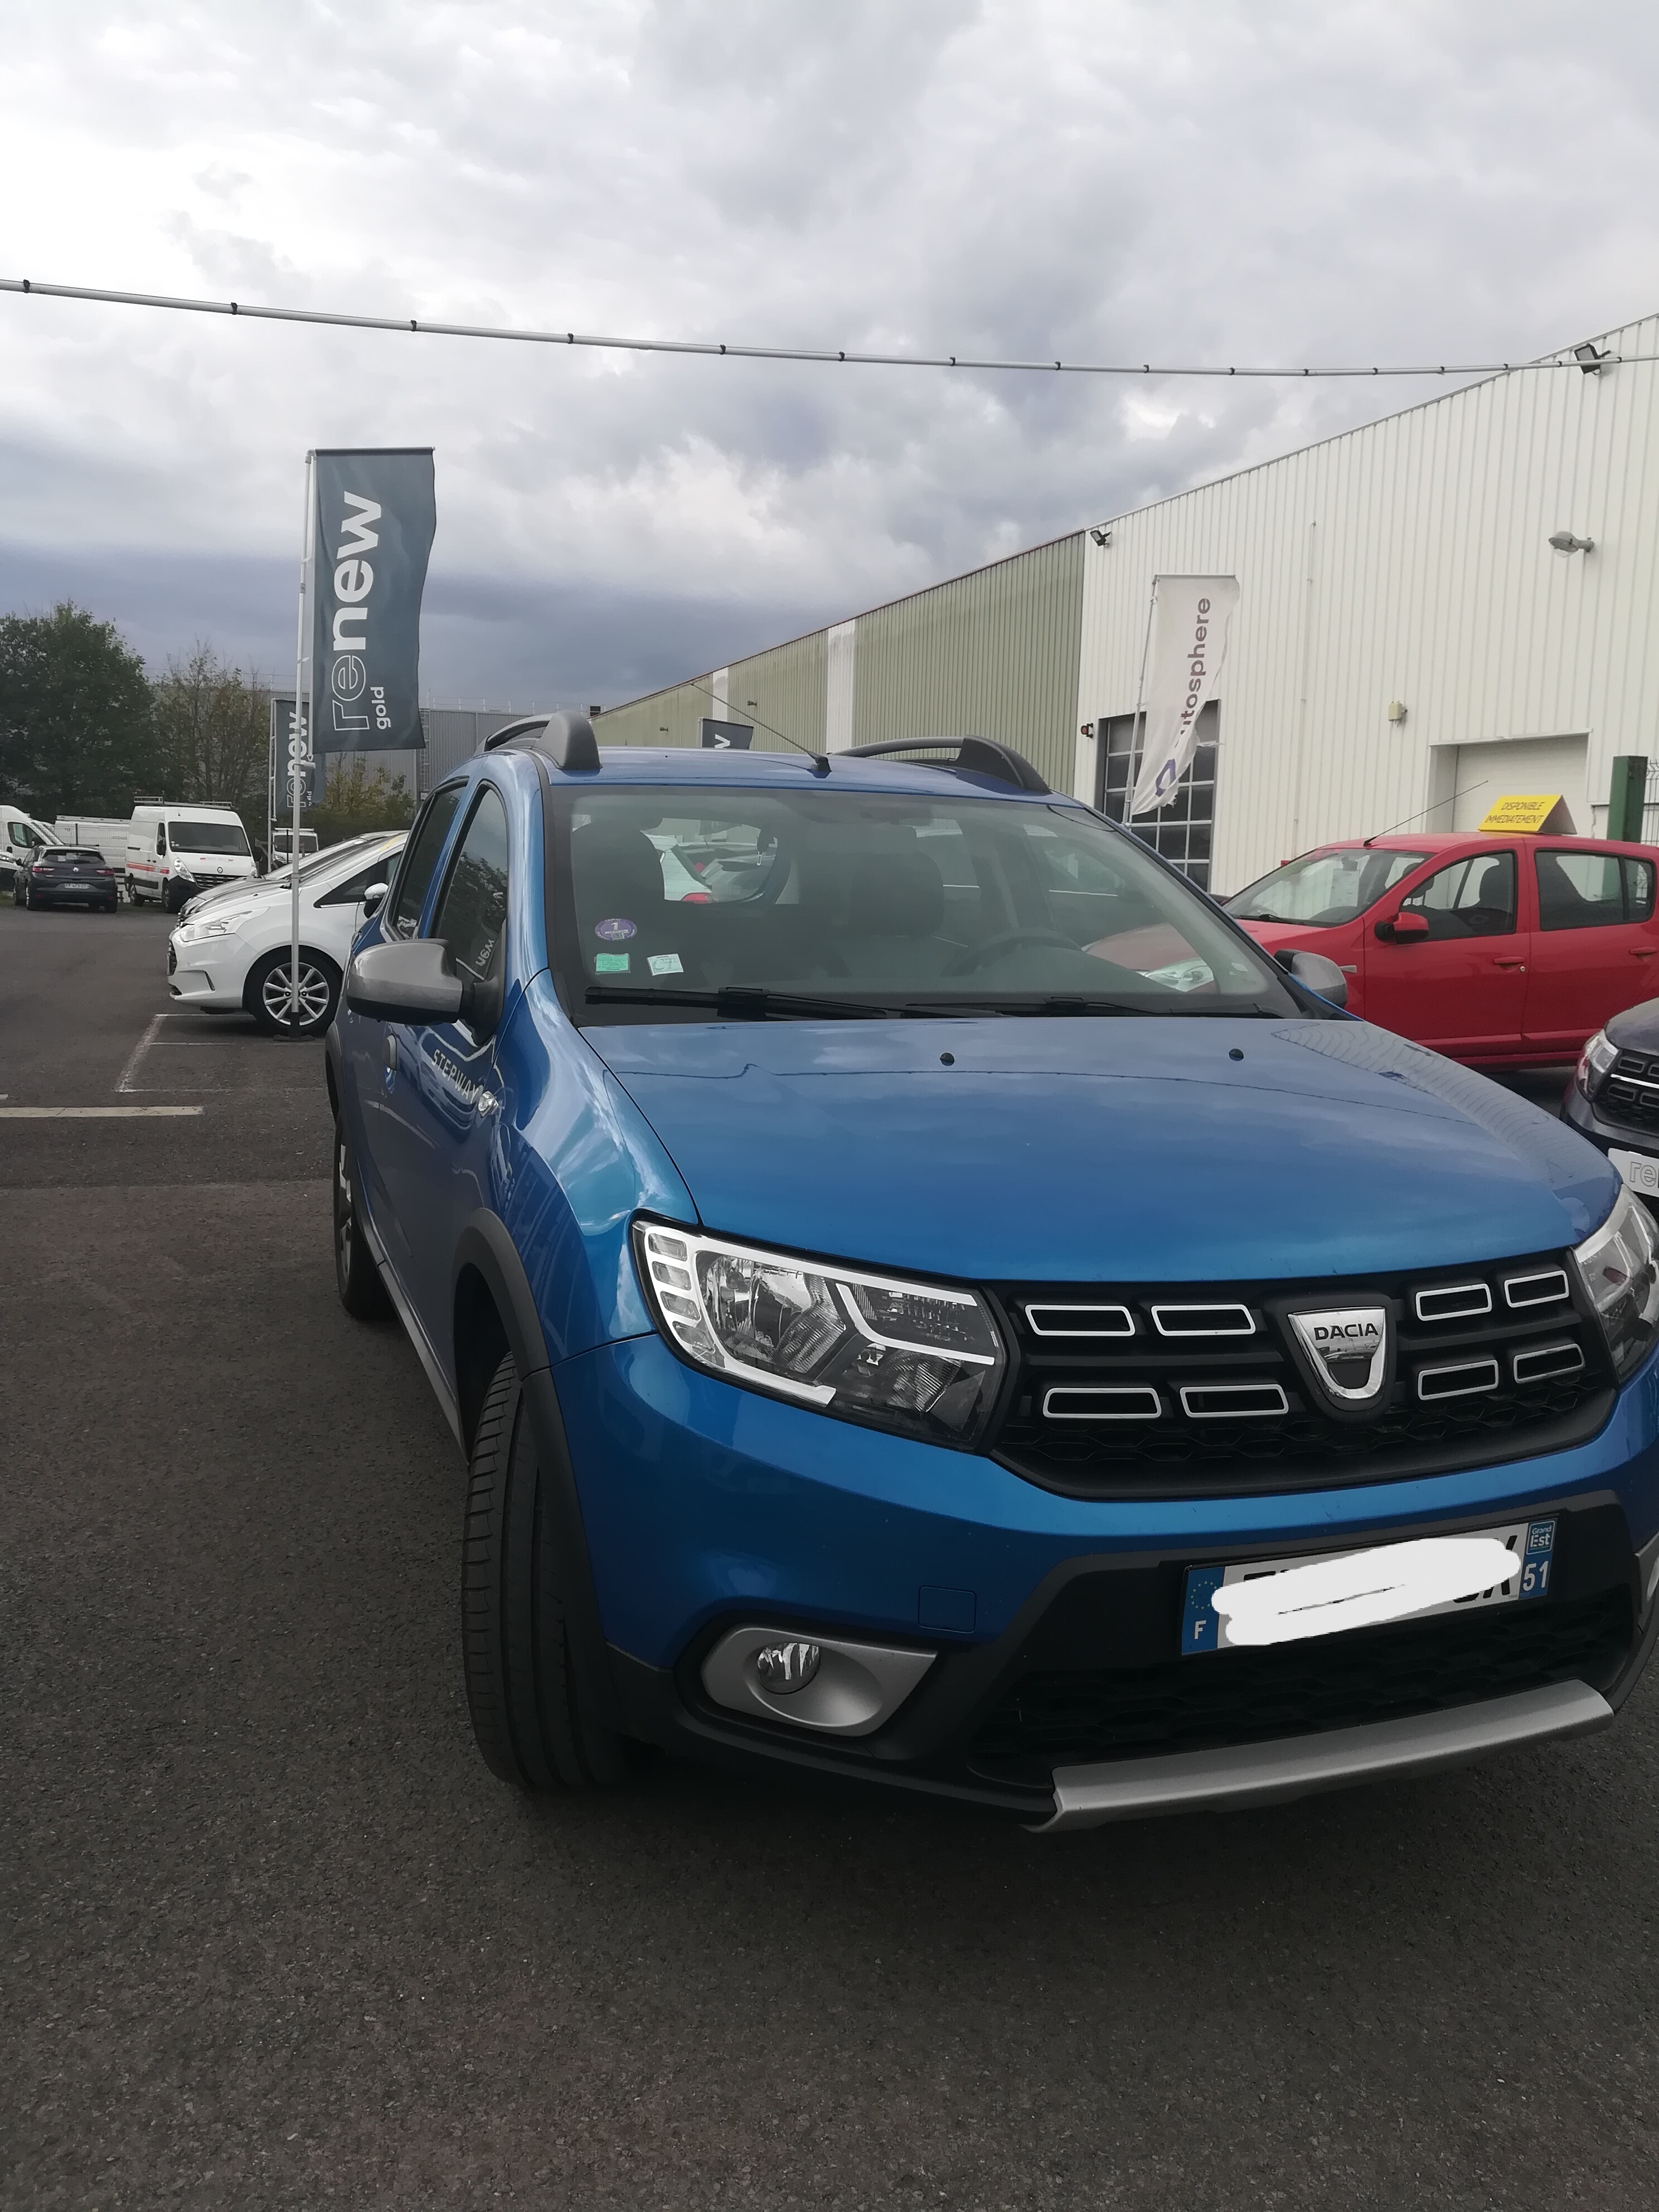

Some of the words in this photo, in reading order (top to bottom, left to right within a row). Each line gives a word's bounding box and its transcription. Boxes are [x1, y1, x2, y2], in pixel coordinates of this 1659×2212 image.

[332, 491, 381, 731] renew
[370, 686, 391, 730] gold
[1501, 802, 1545, 810] DISPONIBLE
[431, 1049, 479, 1104] STEPWAY
[1629, 1161, 1659, 1188] re
[1314, 1323, 1379, 1341] DACIA
[1530, 1533, 1551, 1548] Est
[1532, 1525, 1552, 1534] Grand
[1523, 1560, 1549, 1592] 51
[1194, 1620, 1207, 1639] F
